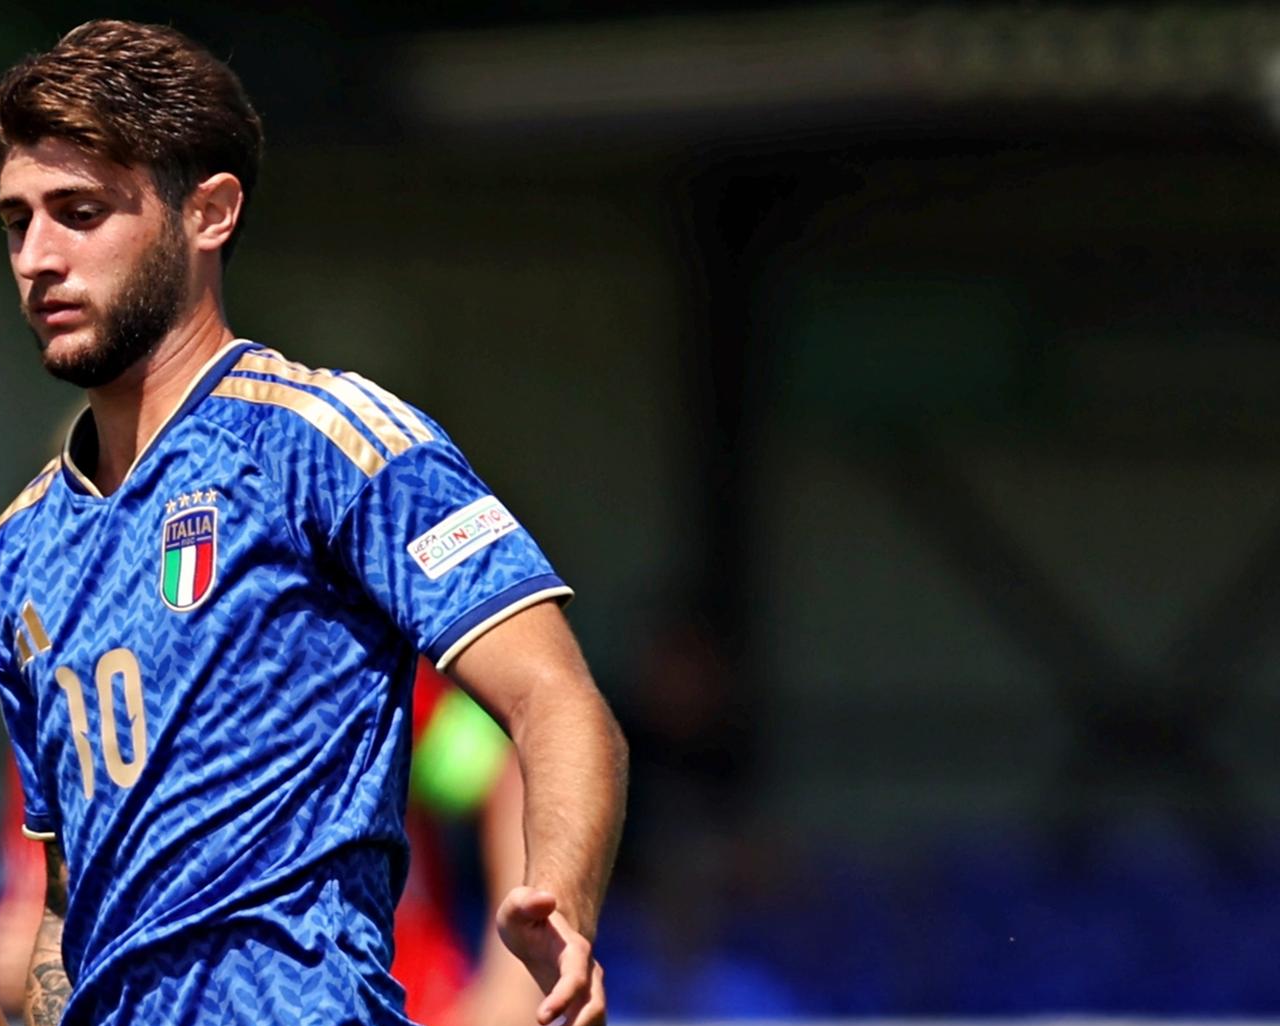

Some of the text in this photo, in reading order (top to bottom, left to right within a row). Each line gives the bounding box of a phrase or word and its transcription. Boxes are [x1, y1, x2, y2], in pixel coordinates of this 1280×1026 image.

[166, 514, 212, 543] ITALIA
[413, 534, 438, 555] UEFA
[55, 647, 147, 801] 10
